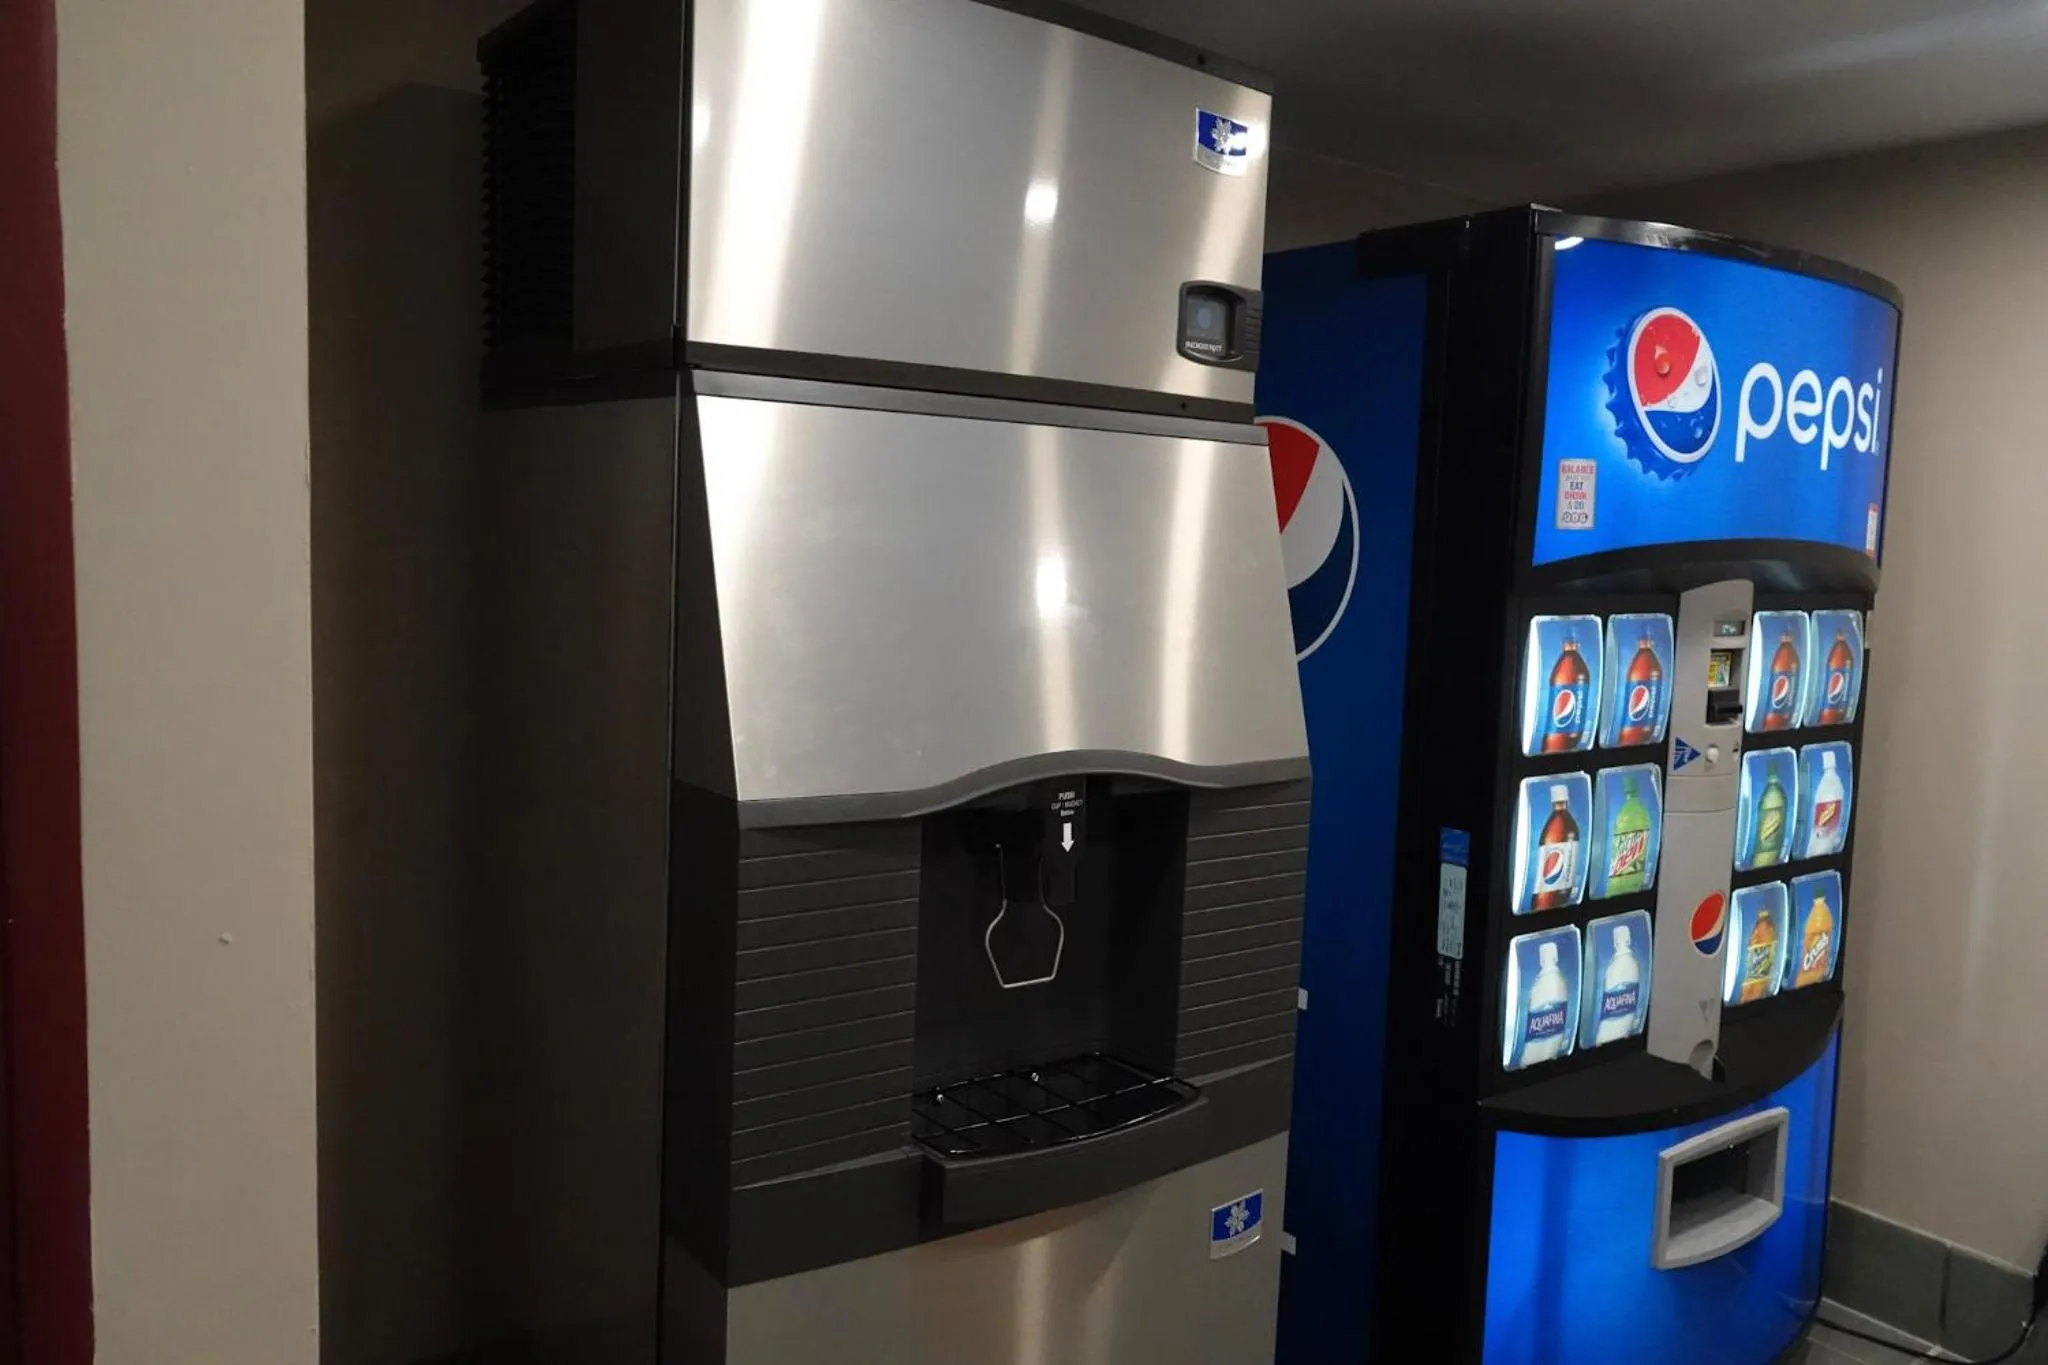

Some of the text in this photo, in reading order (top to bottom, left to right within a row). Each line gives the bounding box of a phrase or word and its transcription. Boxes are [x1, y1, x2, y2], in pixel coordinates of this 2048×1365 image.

[1735, 362, 1883, 471] pepsi
[1570, 481, 1584, 490] EAT
[1528, 1011, 1565, 1034] AQUAFINA
